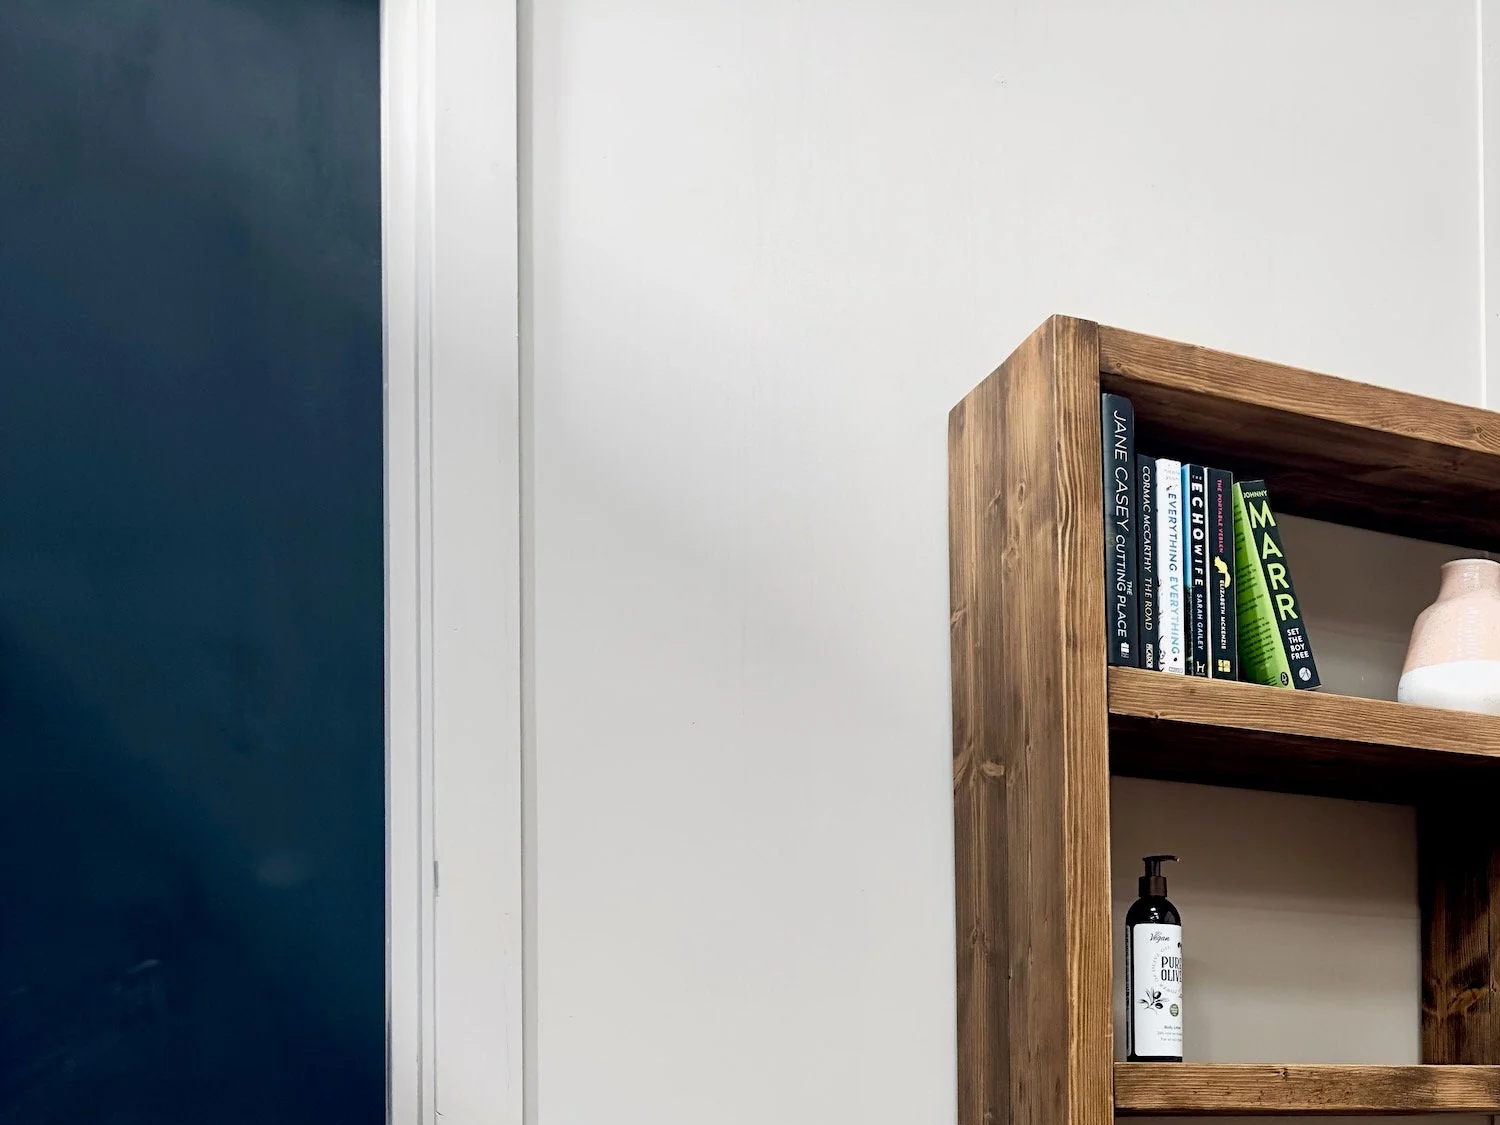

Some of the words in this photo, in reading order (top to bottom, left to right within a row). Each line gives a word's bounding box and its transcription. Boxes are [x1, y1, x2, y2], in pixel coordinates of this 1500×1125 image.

[1113, 409, 1128, 463] JANE
[1114, 466, 1131, 532] CASEY
[1142, 465, 1152, 513] CORMAC
[1243, 490, 1268, 499] JOHNNY
[1167, 493, 1178, 572] EVERYTHING
[1191, 482, 1204, 541] ECHO
[1116, 534, 1127, 592] CUTTING
[1194, 544, 1204, 587] WIFE
[1248, 500, 1299, 622] MARR
[1144, 577, 1153, 598] THE
[1196, 593, 1204, 620] SARAH
[1117, 594, 1128, 638] PLACE
[1145, 600, 1153, 631] ROAD
[1169, 576, 1180, 655] EVERYTHING
[1286, 627, 1300, 637] SET
[1288, 635, 1304, 645] THE
[1290, 643, 1306, 653] BOY
[1291, 650, 1310, 661] FREE
